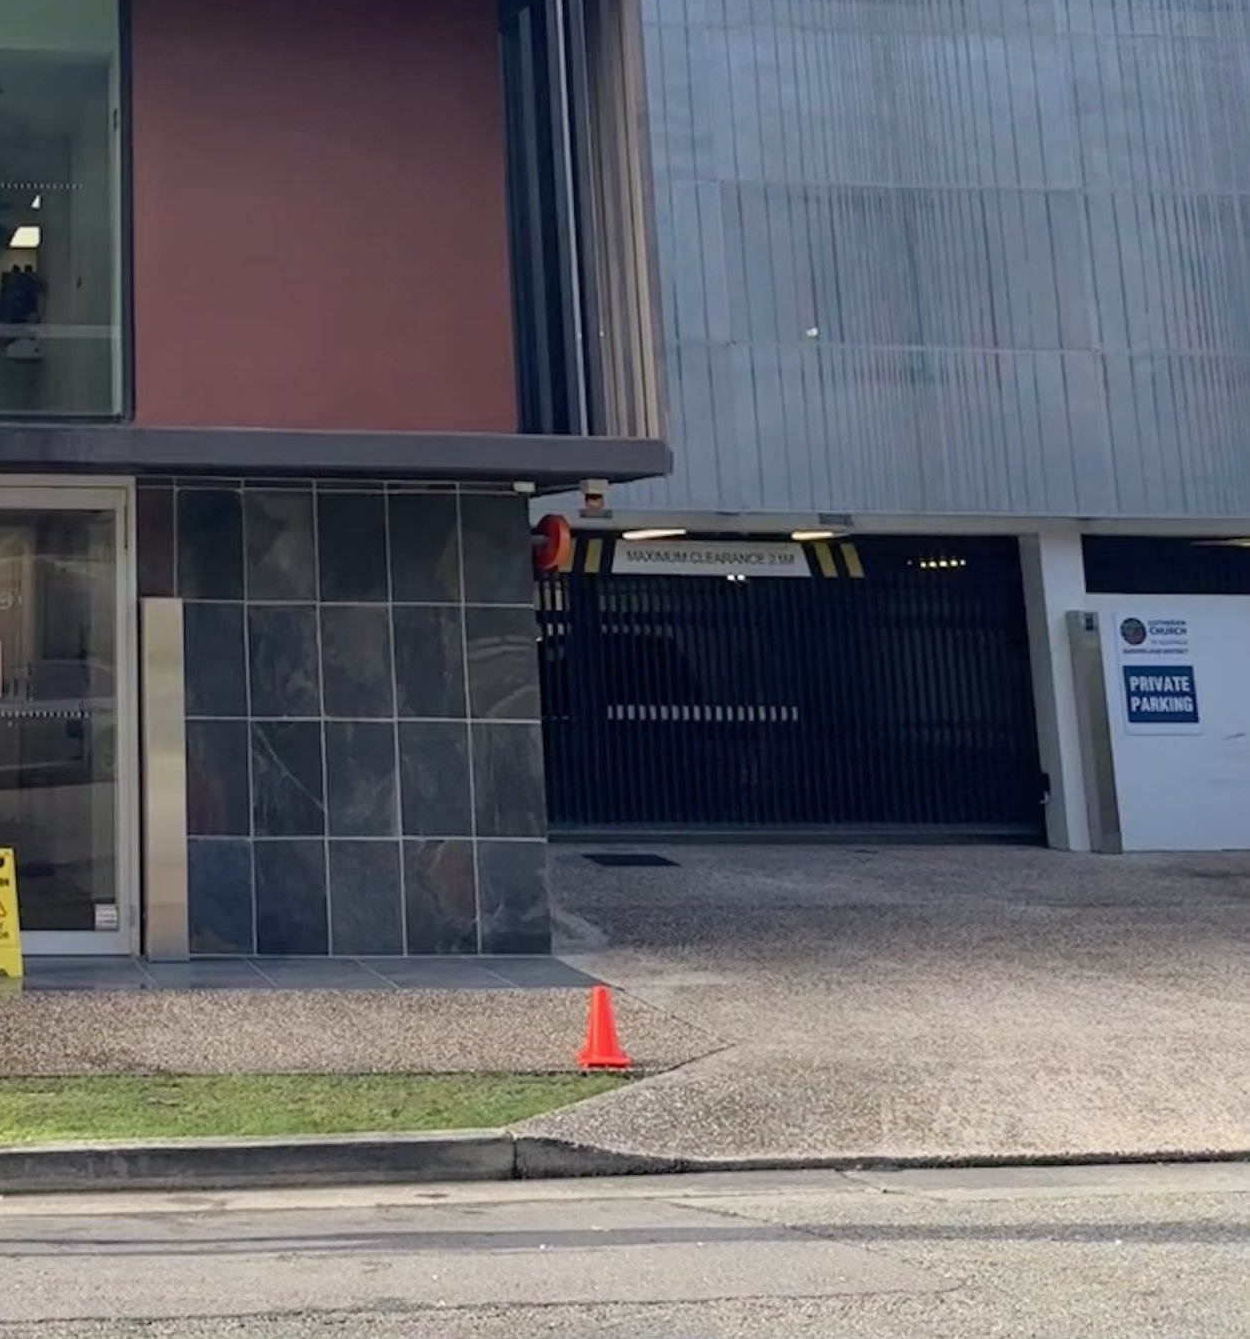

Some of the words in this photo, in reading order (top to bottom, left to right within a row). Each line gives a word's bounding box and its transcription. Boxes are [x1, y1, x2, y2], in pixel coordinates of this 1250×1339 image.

[626, 550, 687, 563] MAXIMUM
[690, 551, 766, 565] CLEARANCE
[1149, 626, 1188, 636] CHURCH
[1129, 676, 1191, 692] PRIVATE
[1130, 696, 1194, 713] PARKING
